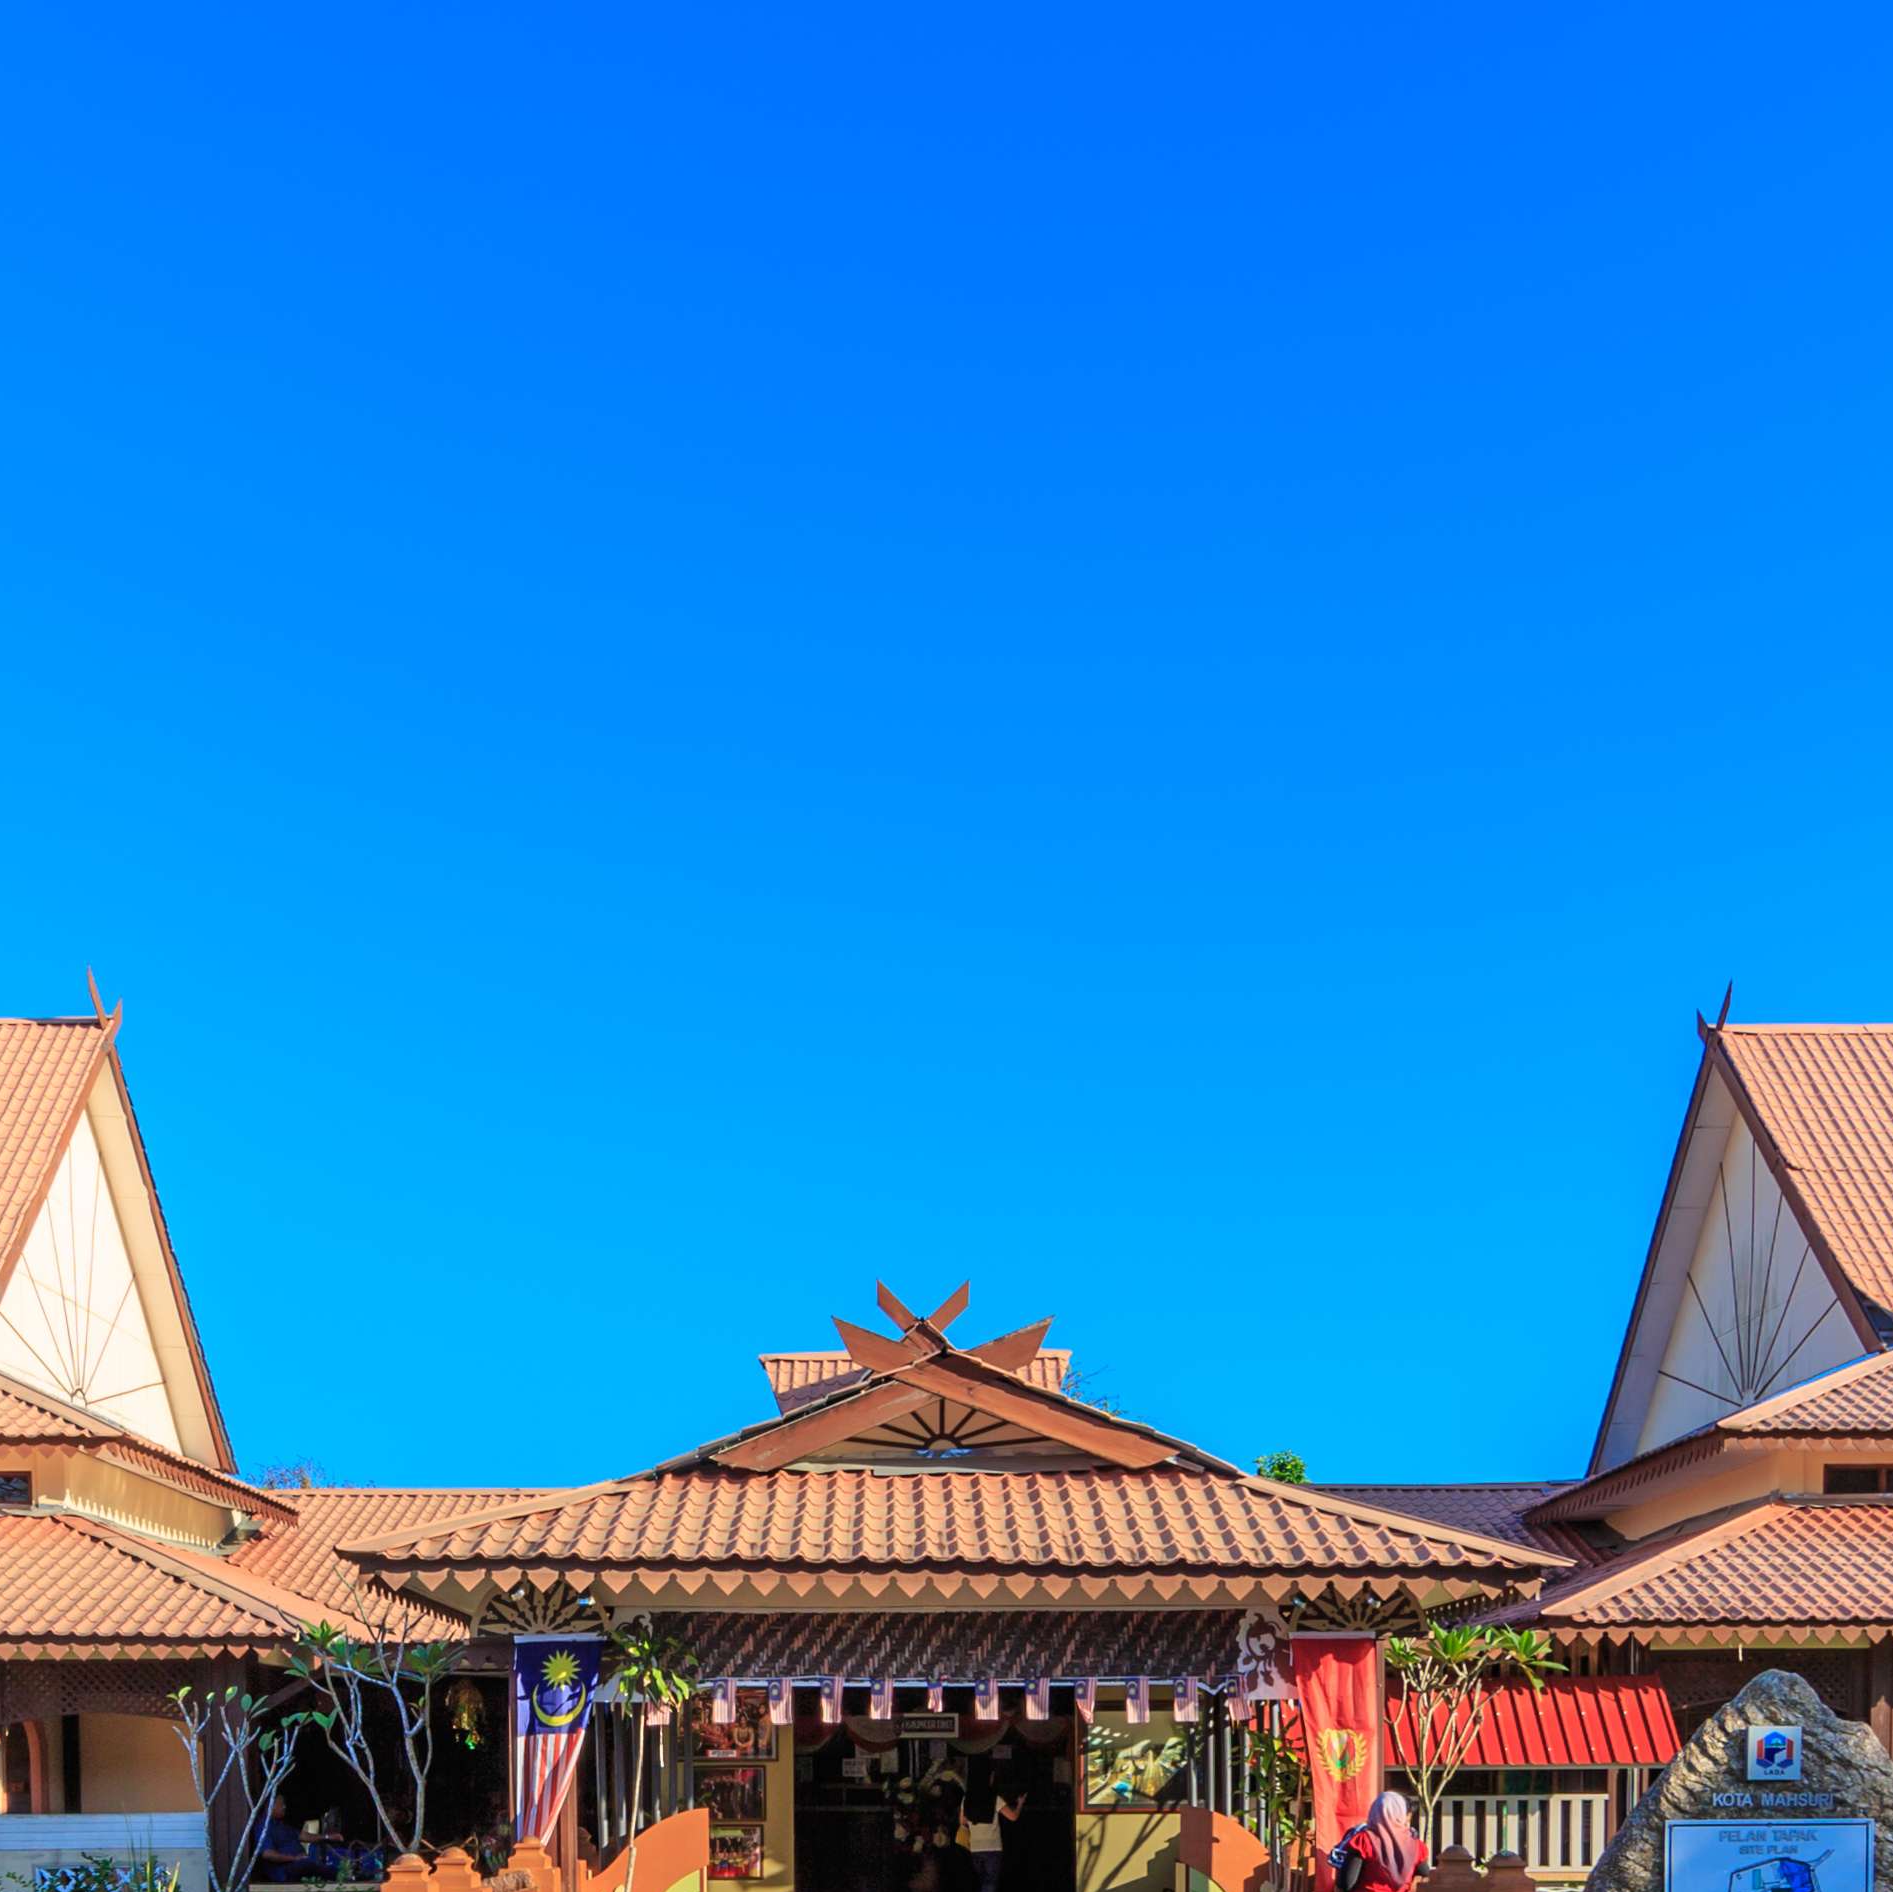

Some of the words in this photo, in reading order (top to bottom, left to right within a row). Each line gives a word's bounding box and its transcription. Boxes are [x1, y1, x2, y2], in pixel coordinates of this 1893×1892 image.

[1712, 1792, 1753, 1807] KOTA
[1761, 1791, 1834, 1807] MAHSURI
[1718, 1830, 1767, 1842] PELAN
[1772, 1829, 1819, 1841] TAPAK
[1739, 1845, 1764, 1854] SITE
[1767, 1845, 1798, 1854] PLAN
